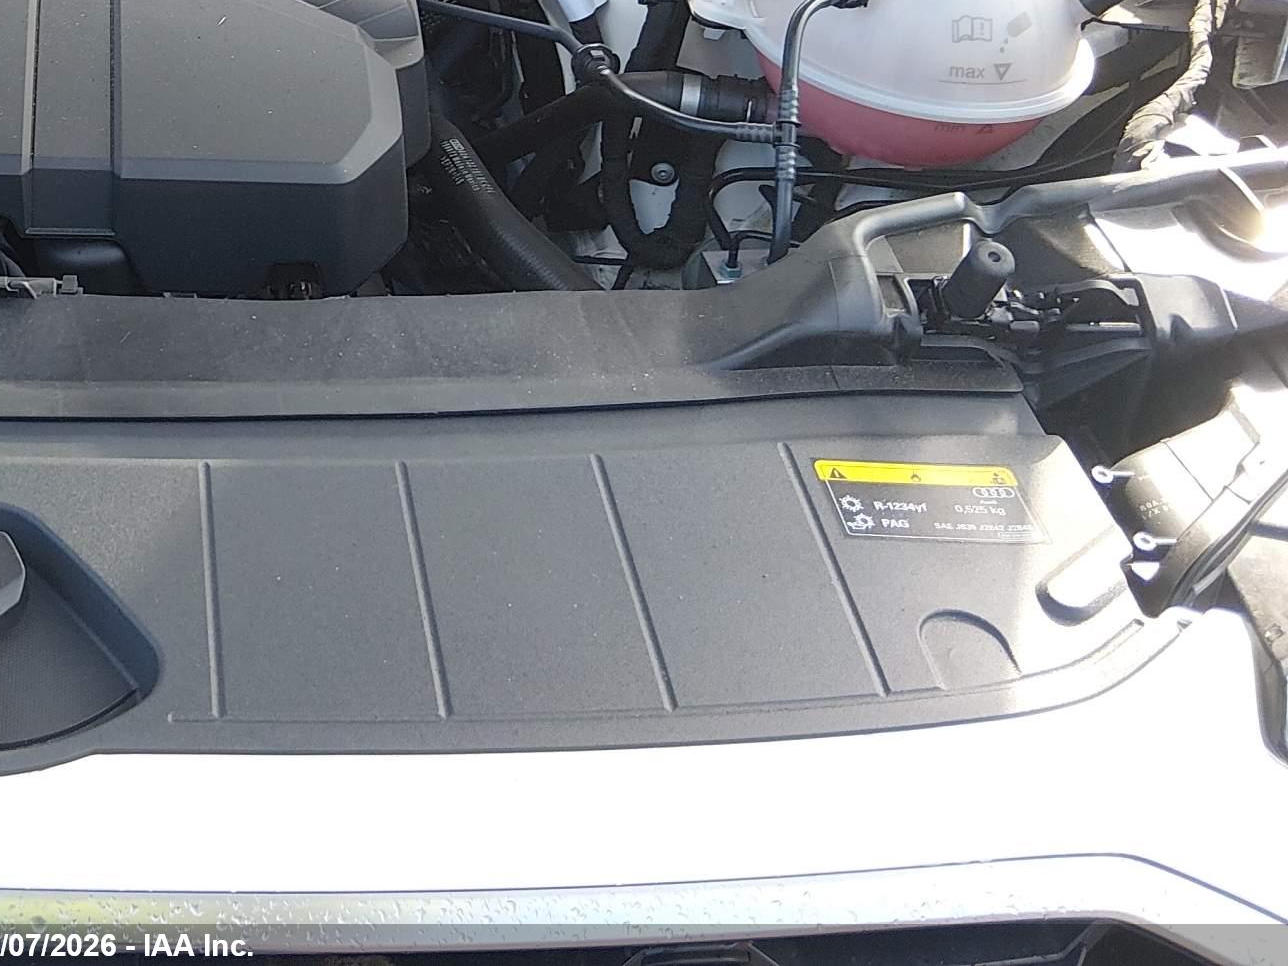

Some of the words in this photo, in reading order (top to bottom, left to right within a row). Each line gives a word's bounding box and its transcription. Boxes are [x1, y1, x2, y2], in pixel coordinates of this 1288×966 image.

[949, 65, 985, 79] max
[874, 501, 928, 512] R-1234yf
[955, 504, 988, 514] 0,525
[990, 505, 1006, 516] kg
[881, 518, 910, 528] PAG
